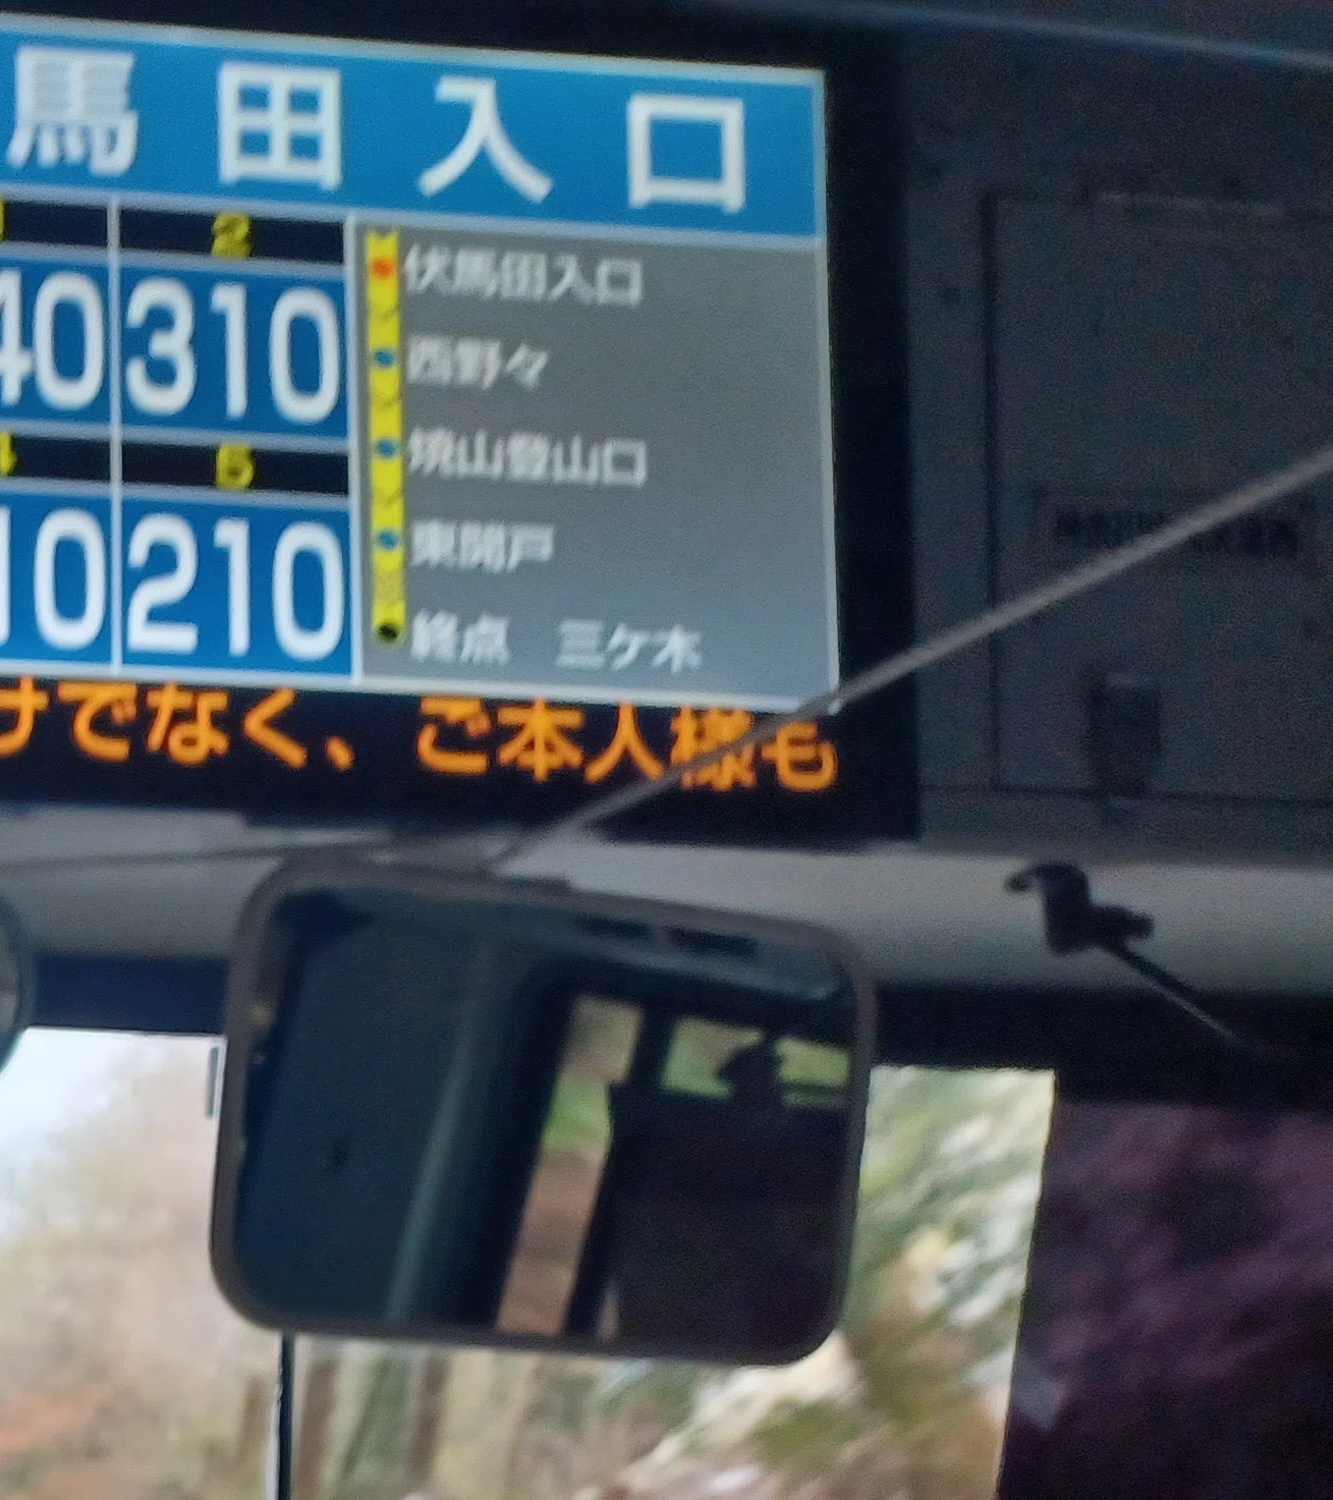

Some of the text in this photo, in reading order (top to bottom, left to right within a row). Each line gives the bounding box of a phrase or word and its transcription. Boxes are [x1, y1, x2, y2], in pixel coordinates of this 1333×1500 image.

[212, 212, 251, 260] 2
[405, 245, 643, 308] 伏馬田入口
[126, 277, 340, 423] 310
[127, 512, 344, 661] 210
